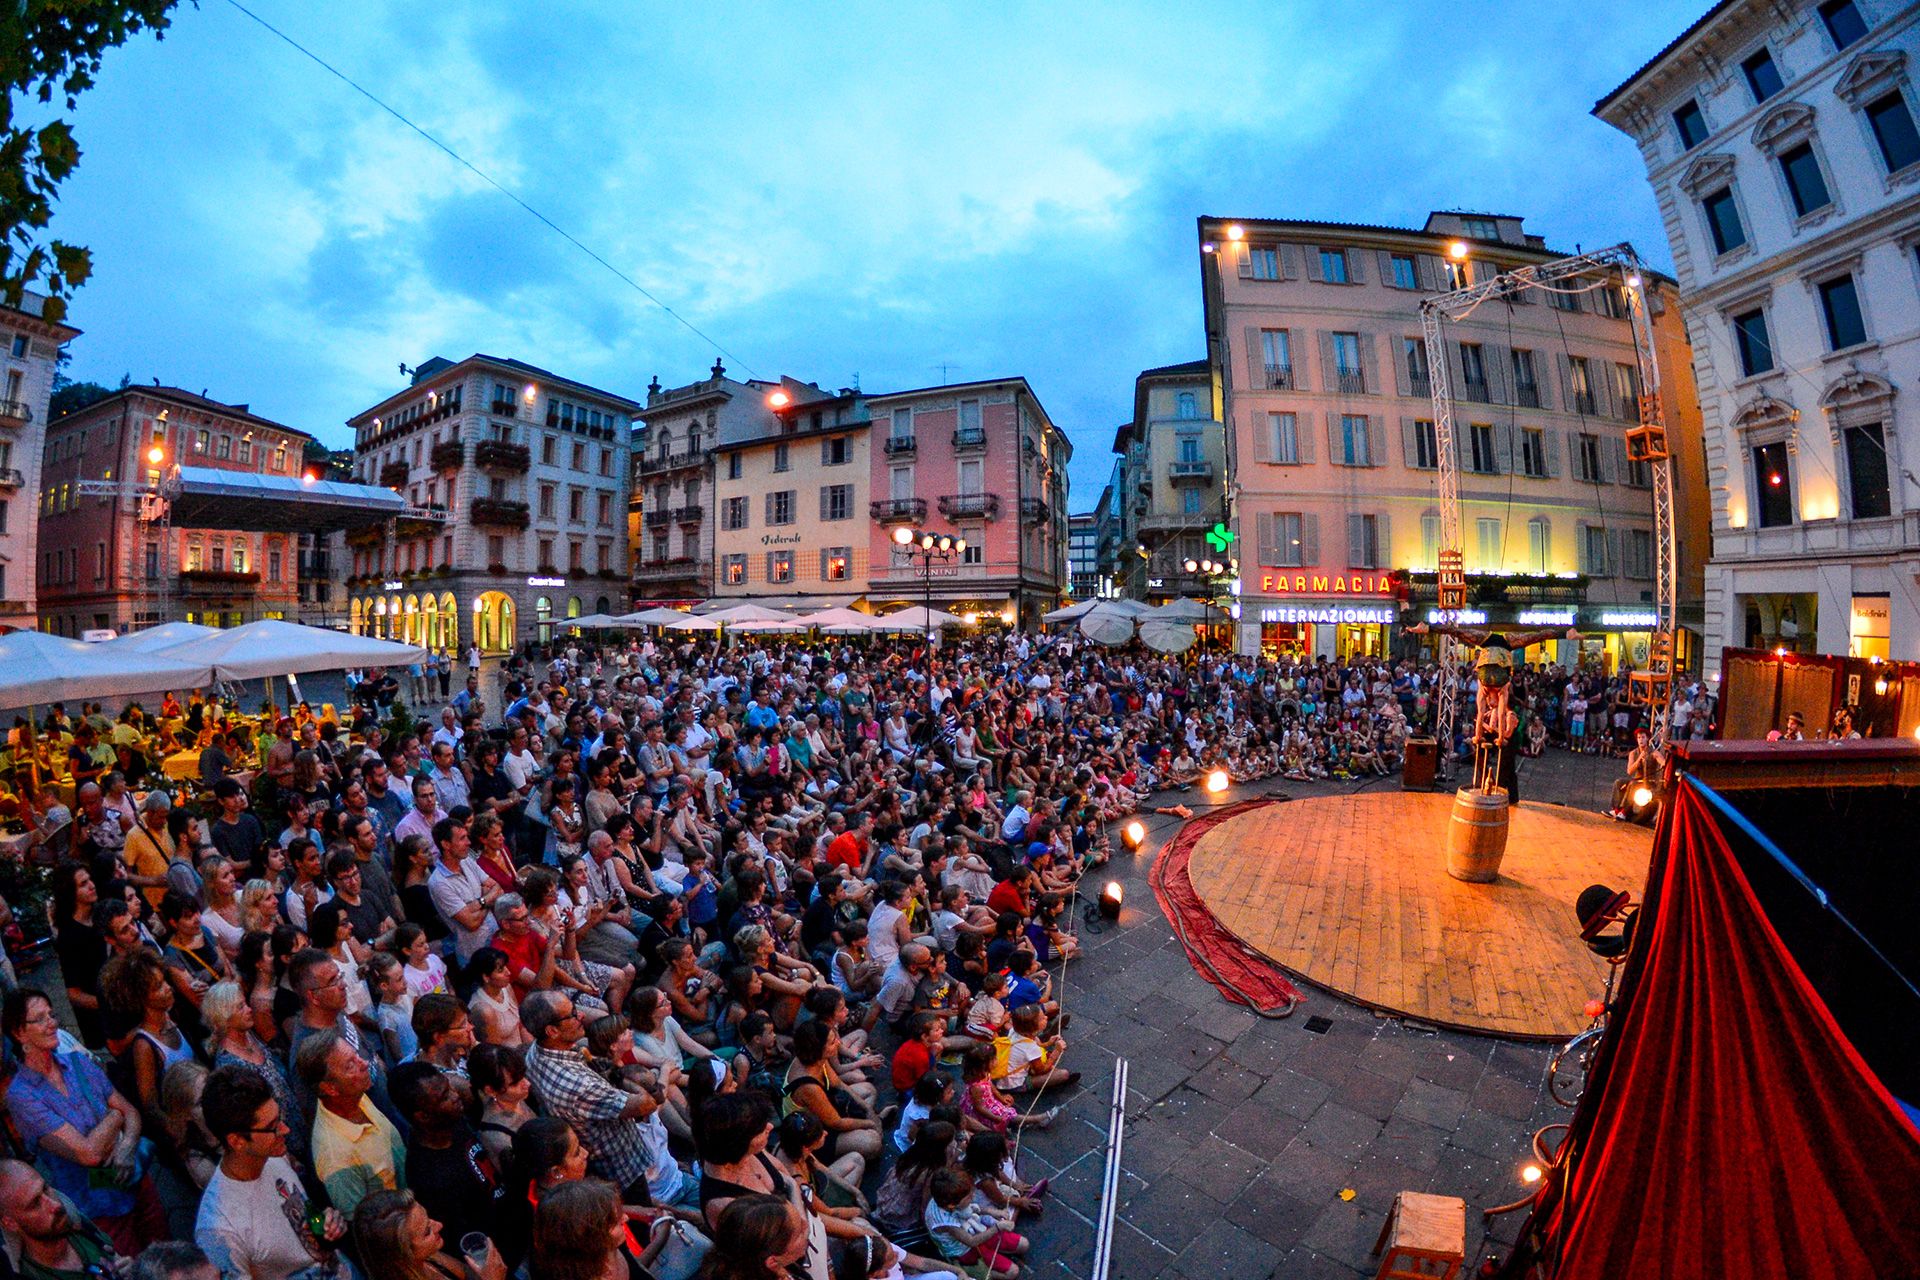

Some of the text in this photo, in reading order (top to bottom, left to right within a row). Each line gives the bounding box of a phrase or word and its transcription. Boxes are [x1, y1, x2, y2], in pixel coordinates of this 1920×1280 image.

[915, 568, 958, 577] VANINI
[1262, 575, 1391, 593] FARMACIA
[1261, 609, 1393, 623] INTERNAZIONALE
